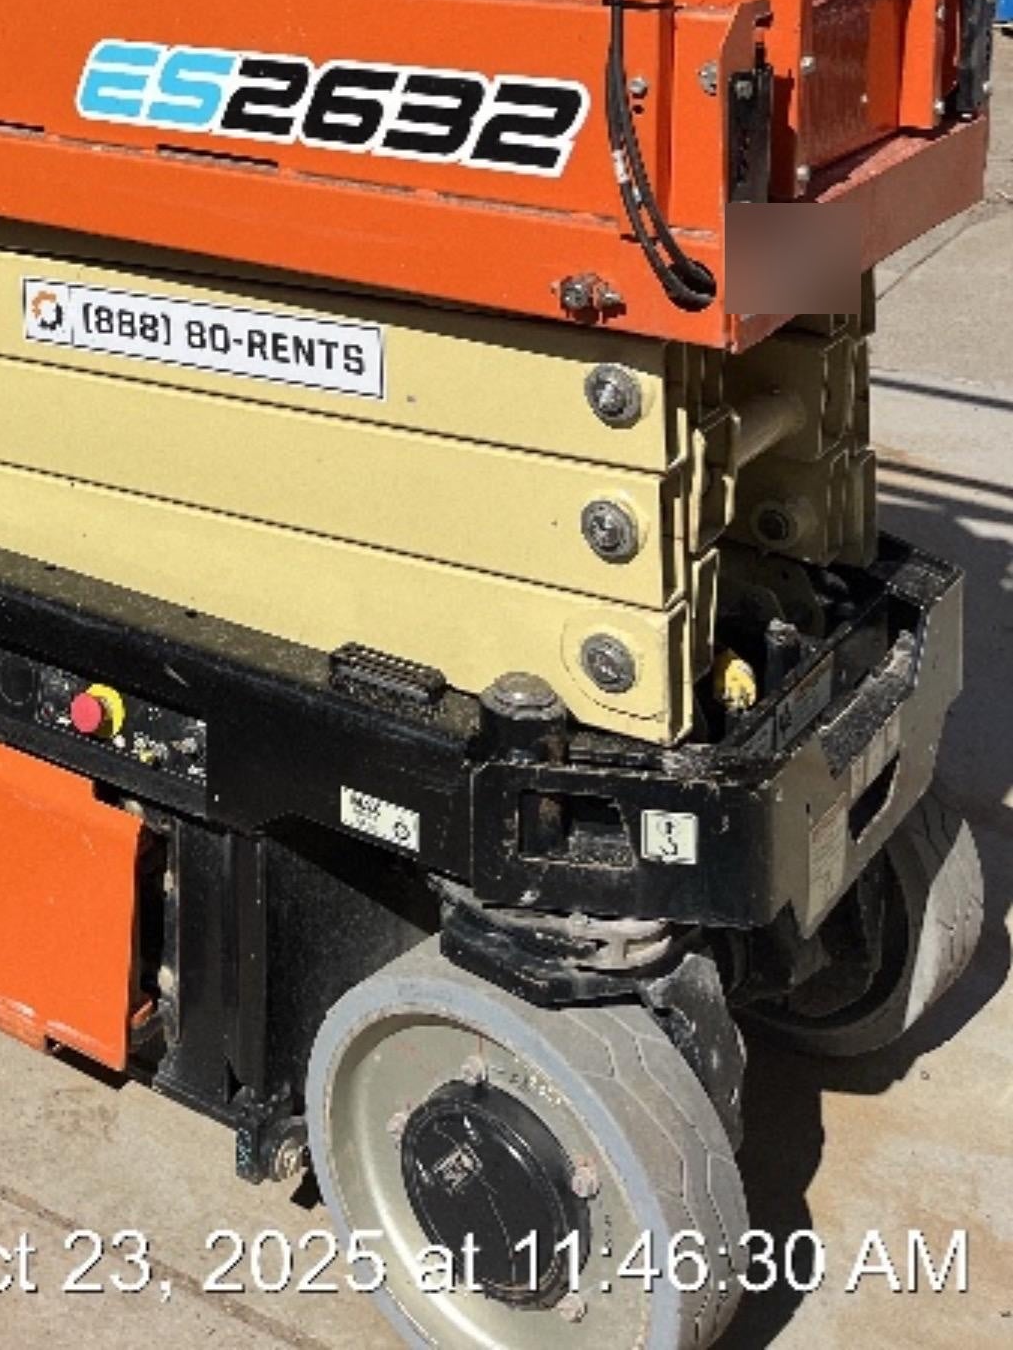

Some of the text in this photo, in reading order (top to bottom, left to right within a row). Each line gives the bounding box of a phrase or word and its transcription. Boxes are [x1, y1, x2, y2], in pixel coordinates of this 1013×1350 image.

[77, 41, 586, 175] ES2632
[81, 302, 366, 377] (888) 80-RENTS
